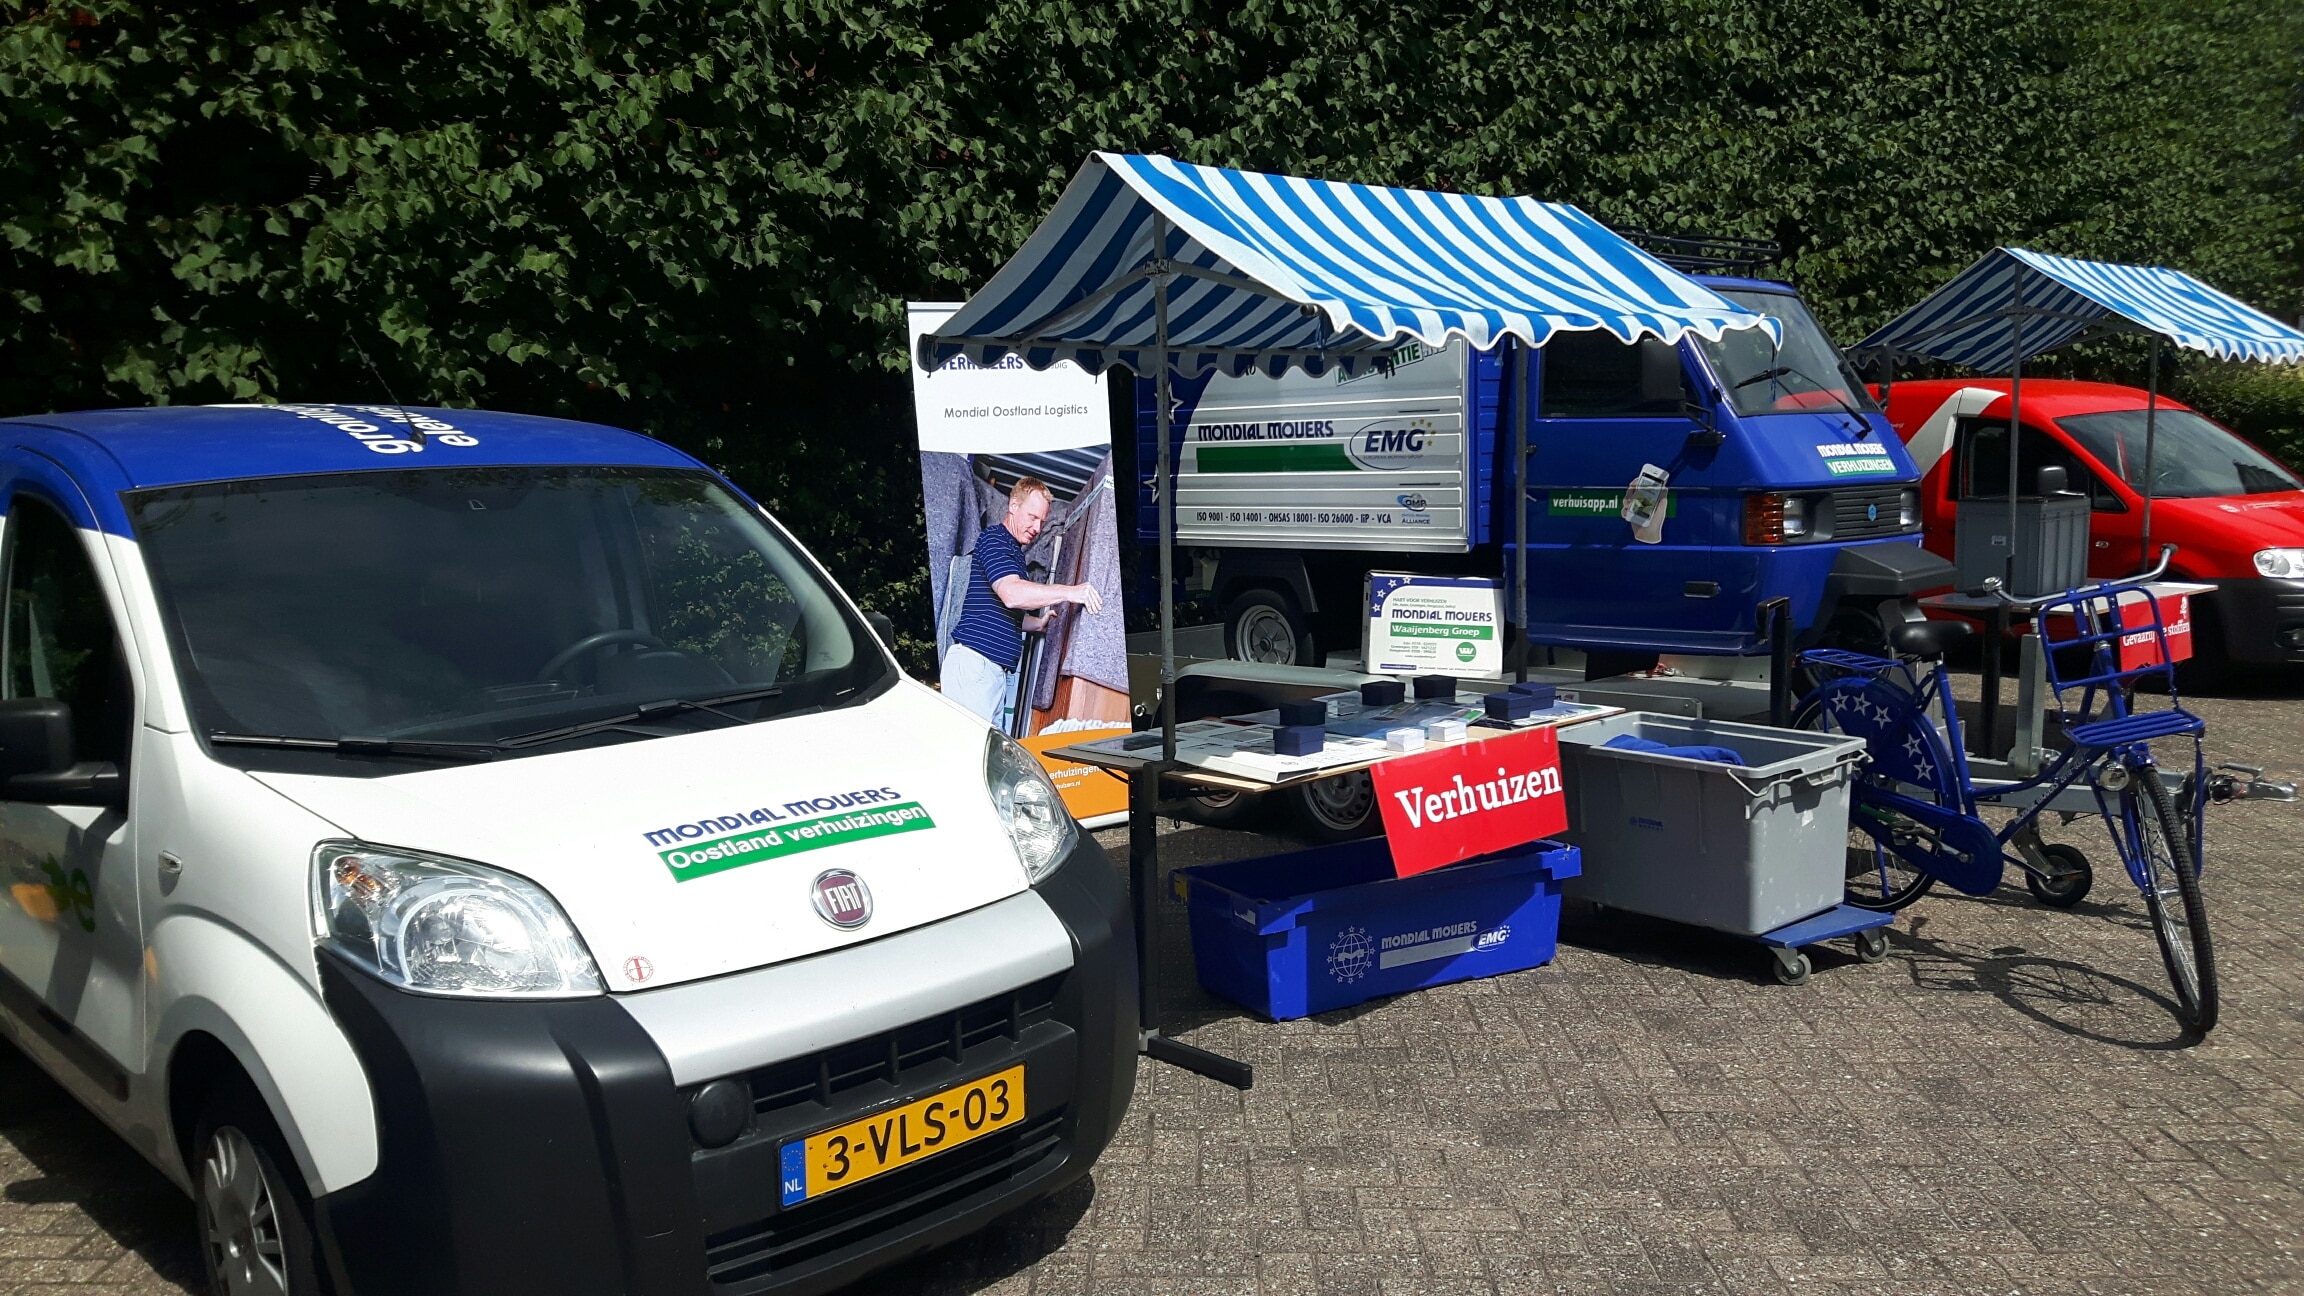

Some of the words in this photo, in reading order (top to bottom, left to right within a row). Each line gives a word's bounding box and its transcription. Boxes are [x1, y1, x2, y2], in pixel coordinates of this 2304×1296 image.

[944, 406, 989, 419] Mondial
[992, 405, 1041, 418] Oostland
[1044, 404, 1088, 418] Logistics
[1198, 423, 1265, 442] MONDIAL
[1267, 420, 1334, 439] MOVERS
[1364, 429, 1426, 453] EMG
[1826, 459, 1897, 474] VERHUIZINGEN
[1552, 494, 1619, 513] verhuisapp.nl
[1196, 511, 1207, 521] ISO
[1208, 511, 1224, 522] 9001
[1229, 512, 1241, 522] ISO
[1242, 512, 1263, 522] 14001
[1268, 512, 1291, 522] OHSAS
[1317, 513, 1330, 523] ISO
[1331, 512, 1354, 524] 26000
[1376, 513, 1392, 524] VCA
[1391, 608, 1442, 620] MONDIAL
[1445, 610, 1493, 622] MOVERS
[1391, 624, 1449, 636] Waaijenberg
[1451, 627, 1480, 637] Groep
[2168, 620, 2191, 637] stoffen
[1394, 767, 1562, 829] Verhuizen
[642, 807, 788, 847] MONDIAL
[782, 786, 902, 818] MOVERS
[667, 830, 784, 869] Oostland
[784, 805, 928, 842] verhuizingen
[824, 882, 864, 915] FIAT
[1381, 932, 1430, 950] MONDIAL
[1431, 920, 1478, 939] MOVERS
[1478, 929, 1507, 946] EMG
[826, 1079, 1010, 1181] 3-VLS-03
[784, 1178, 803, 1195] NL
